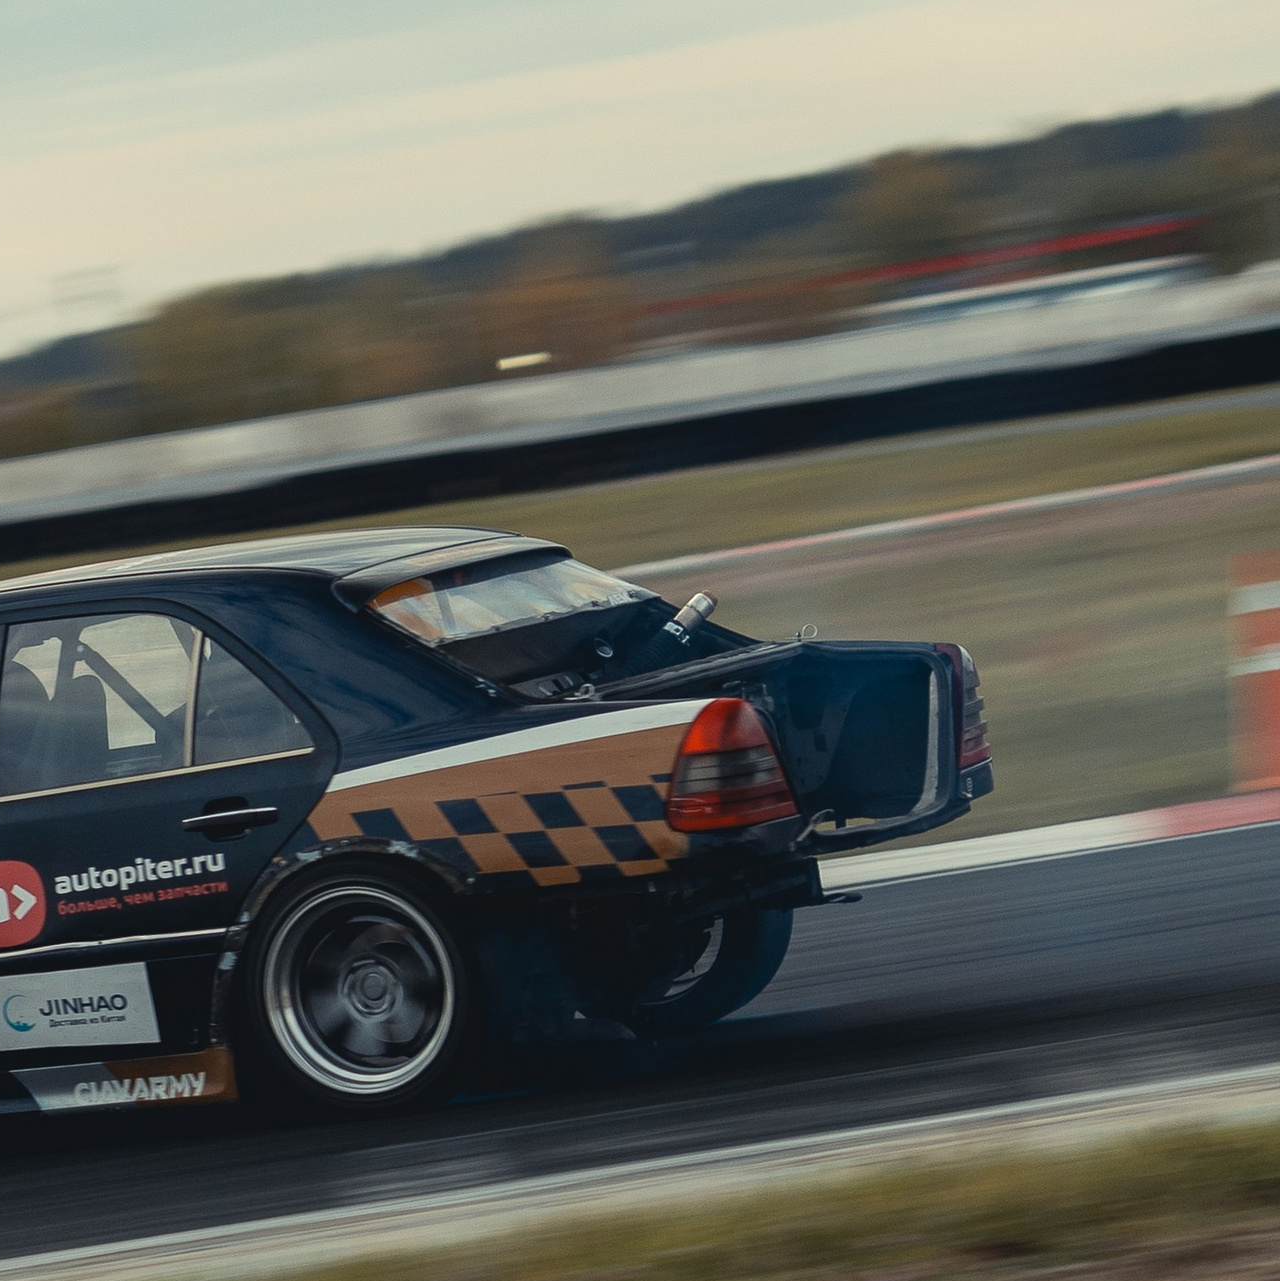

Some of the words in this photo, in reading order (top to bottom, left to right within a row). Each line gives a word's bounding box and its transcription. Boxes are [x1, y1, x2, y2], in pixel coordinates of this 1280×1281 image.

[54, 853, 226, 894] autopiter.ru
[123, 891, 155, 905] чем
[157, 881, 228, 901] запчасти
[39, 994, 128, 1017] JINHAO
